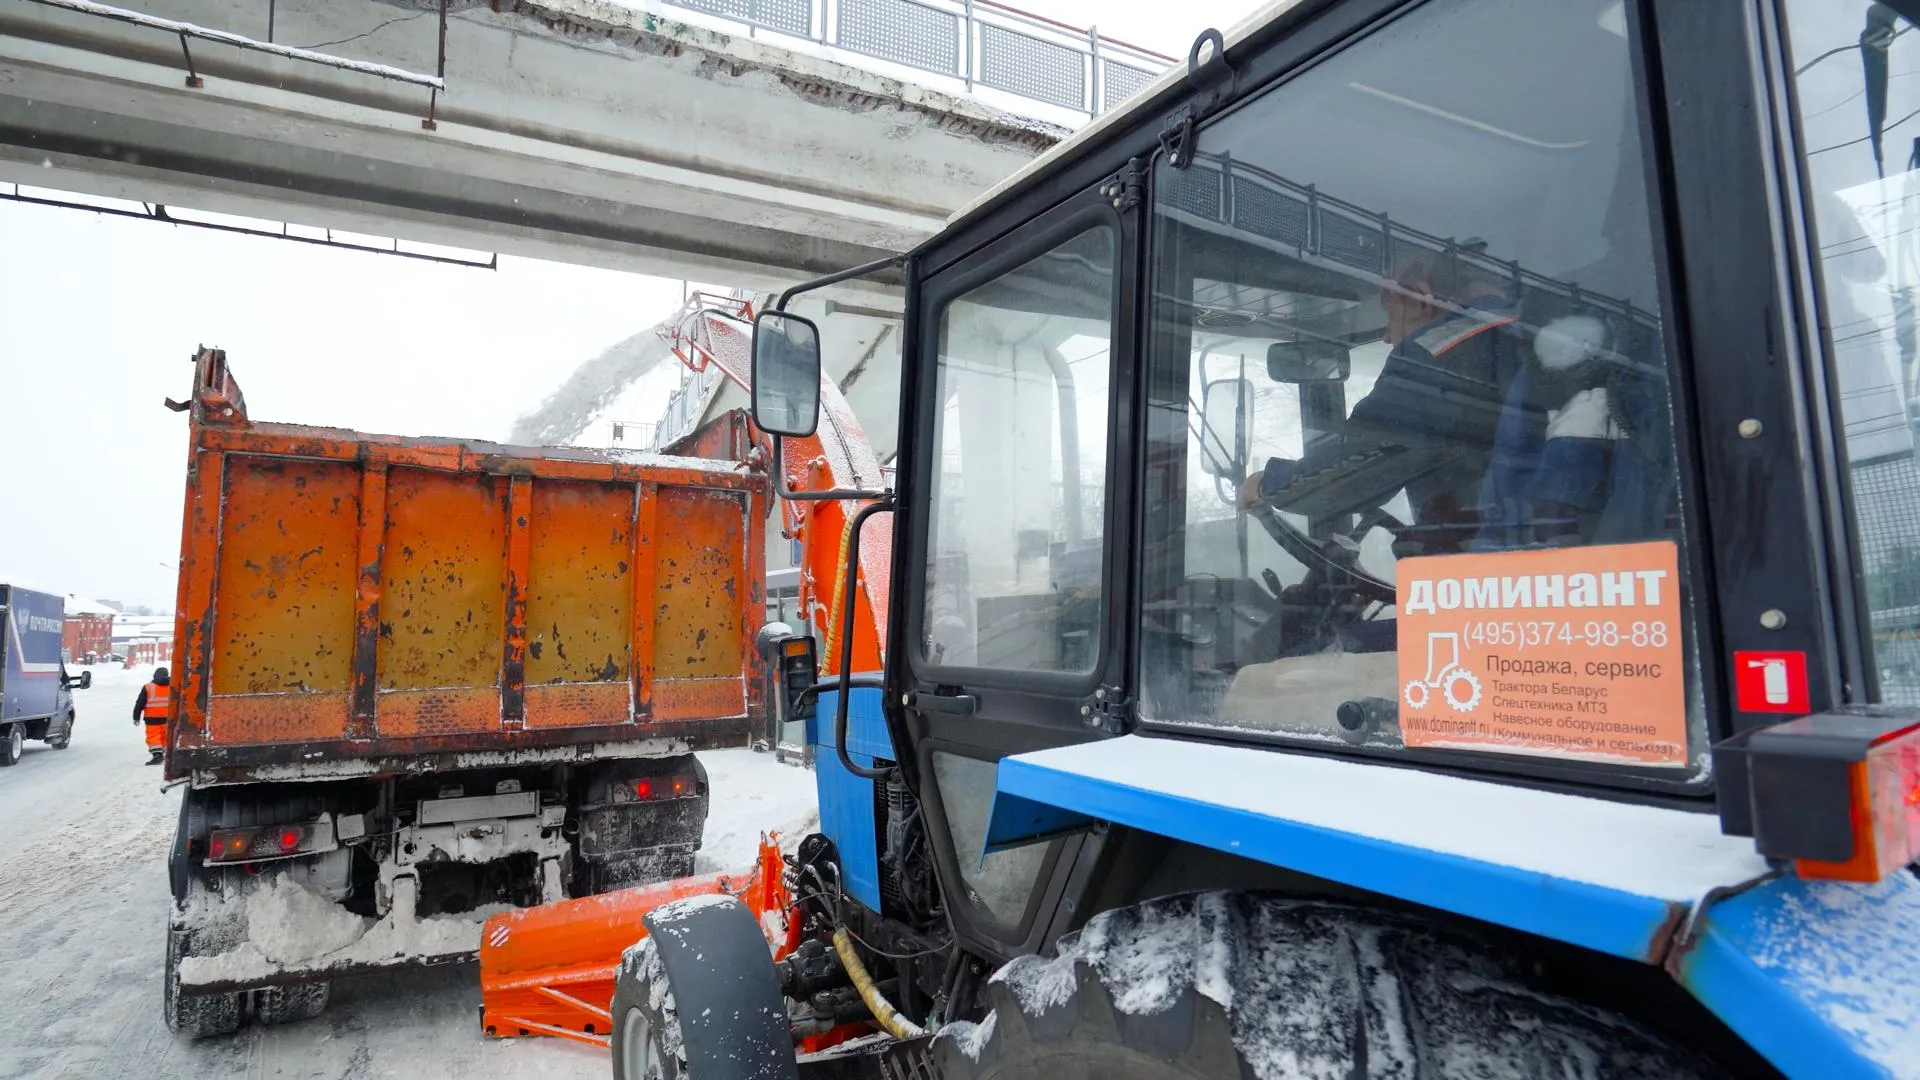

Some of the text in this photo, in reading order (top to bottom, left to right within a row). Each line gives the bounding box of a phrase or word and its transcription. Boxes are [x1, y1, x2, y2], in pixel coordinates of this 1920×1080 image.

[1463, 621, 1668, 650] (495)374-98-88
[1486, 655, 1662, 679] Продажа, сервис
[1492, 680, 1608, 698] Трактора Беларус
[1492, 695, 1609, 714] Спецтехника МТЗ
[1493, 711, 1657, 736] Навесное оборудование
[1597, 739, 1605, 750] и
